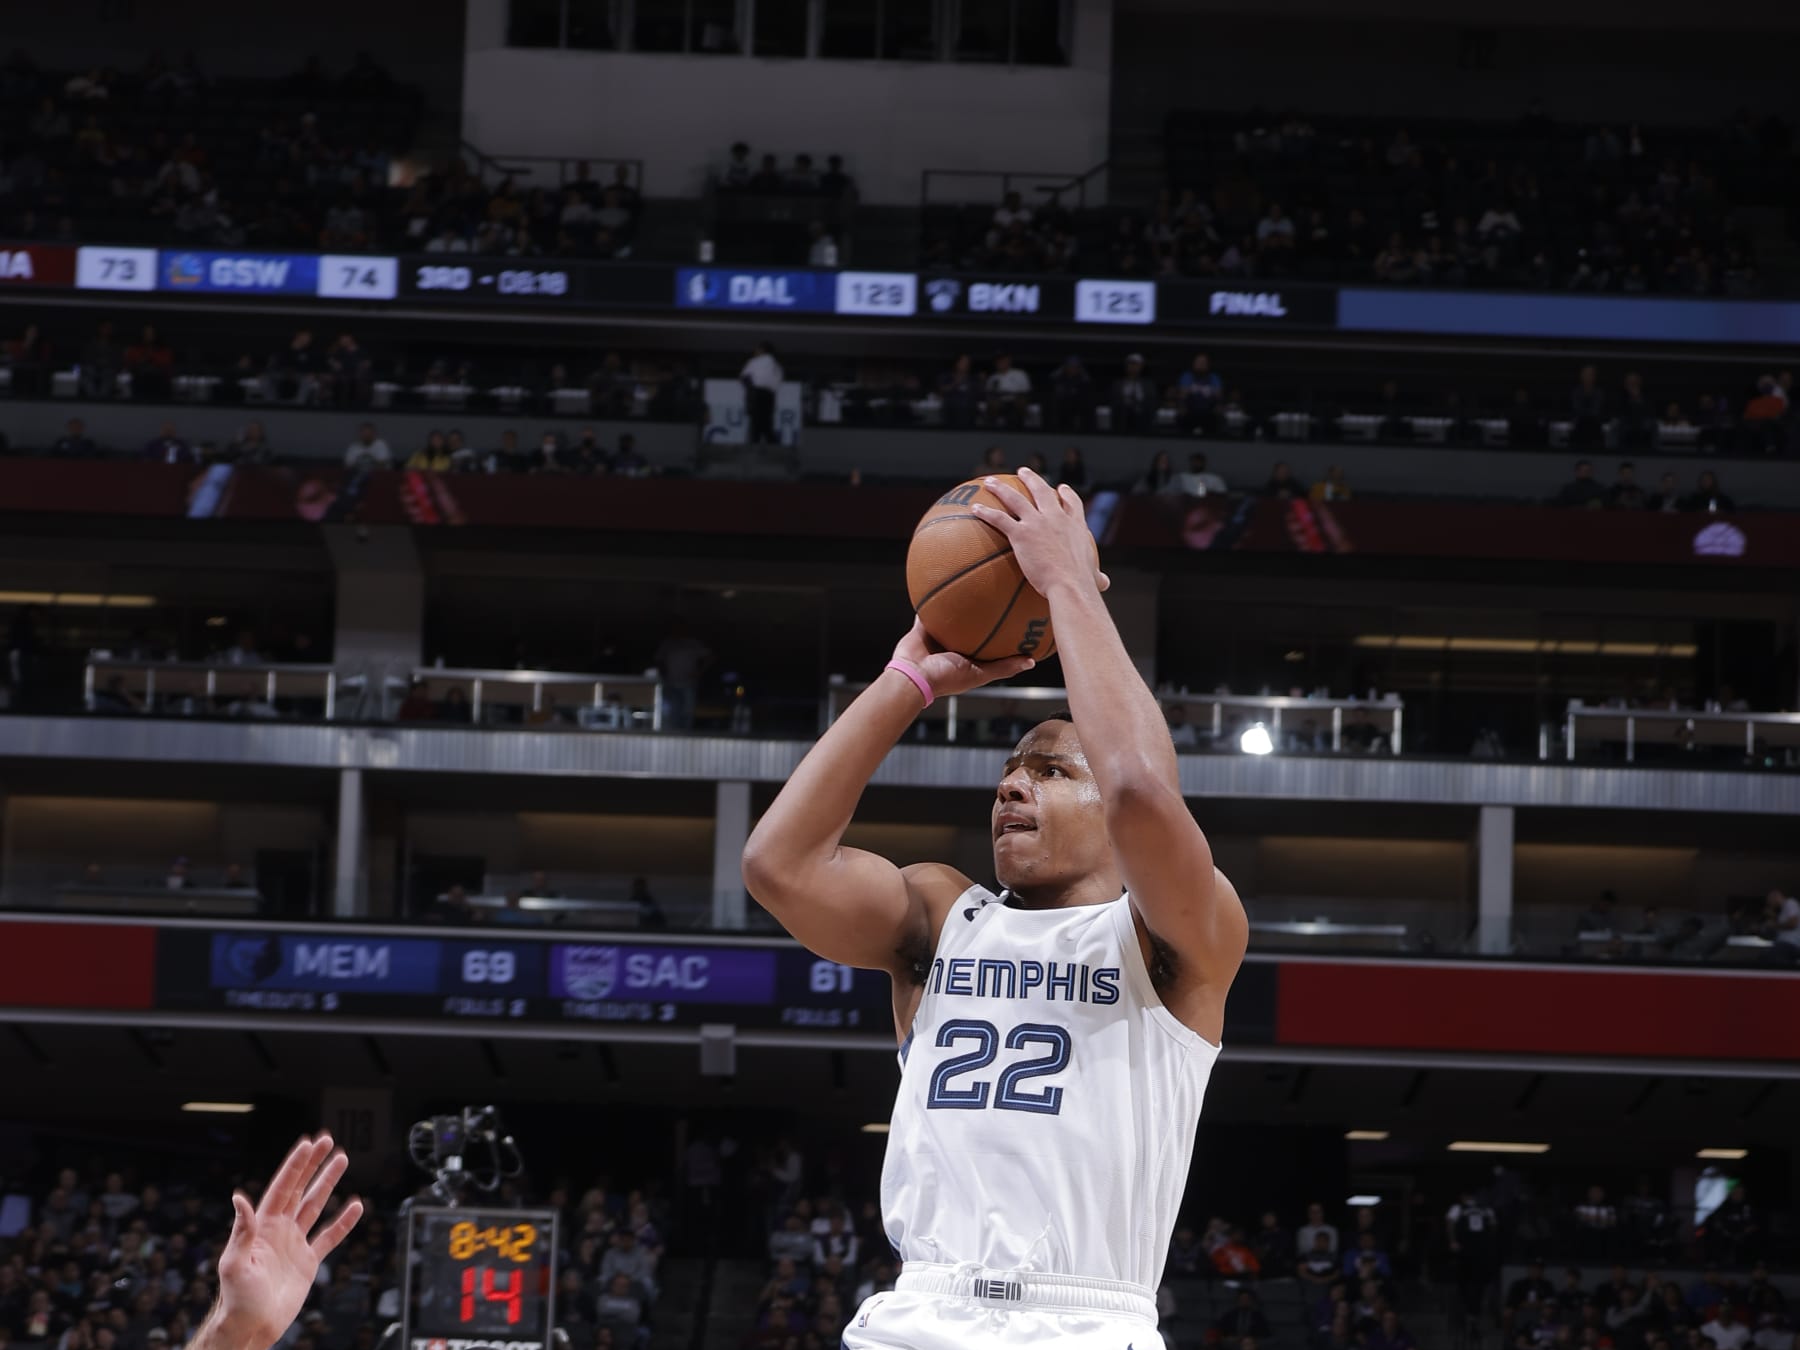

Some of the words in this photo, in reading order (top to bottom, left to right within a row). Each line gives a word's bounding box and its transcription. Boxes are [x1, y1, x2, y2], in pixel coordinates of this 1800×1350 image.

[98, 258, 137, 281] 73
[210, 258, 290, 287] GSW
[341, 266, 378, 290] 74
[416, 264, 471, 291] 3RD
[729, 275, 796, 305] DAL
[968, 282, 1041, 313] BKN
[1090, 291, 1145, 314] 125
[1209, 290, 1288, 317] FINAL
[293, 943, 391, 980] MEM
[461, 949, 517, 984] 69
[624, 953, 710, 991] SAC
[809, 961, 854, 994] 61
[443, 996, 505, 1017] FOULS
[780, 1008, 844, 1028] FOULS
[927, 1018, 1072, 1116] 22
[449, 1221, 537, 1262] 8:42
[460, 1266, 523, 1325] 14
